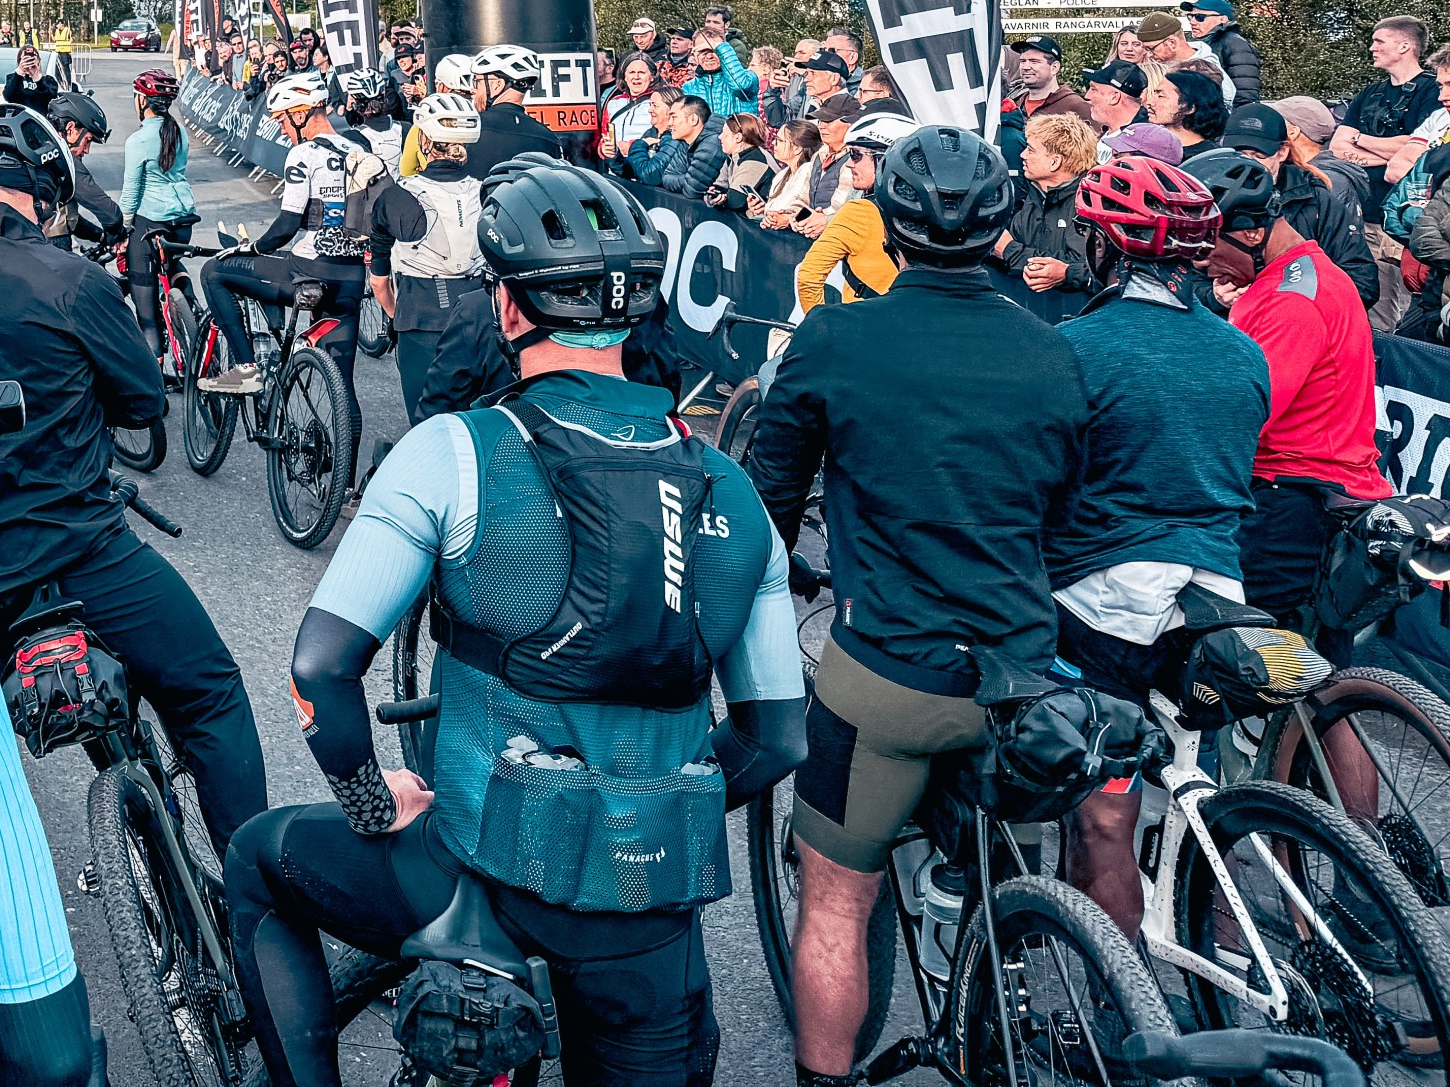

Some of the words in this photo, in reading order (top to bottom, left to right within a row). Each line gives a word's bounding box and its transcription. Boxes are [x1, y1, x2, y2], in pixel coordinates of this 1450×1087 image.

[557, 110, 596, 127] RACE
[223, 258, 255, 271] RAPHA
[658, 479, 685, 614] USWE
